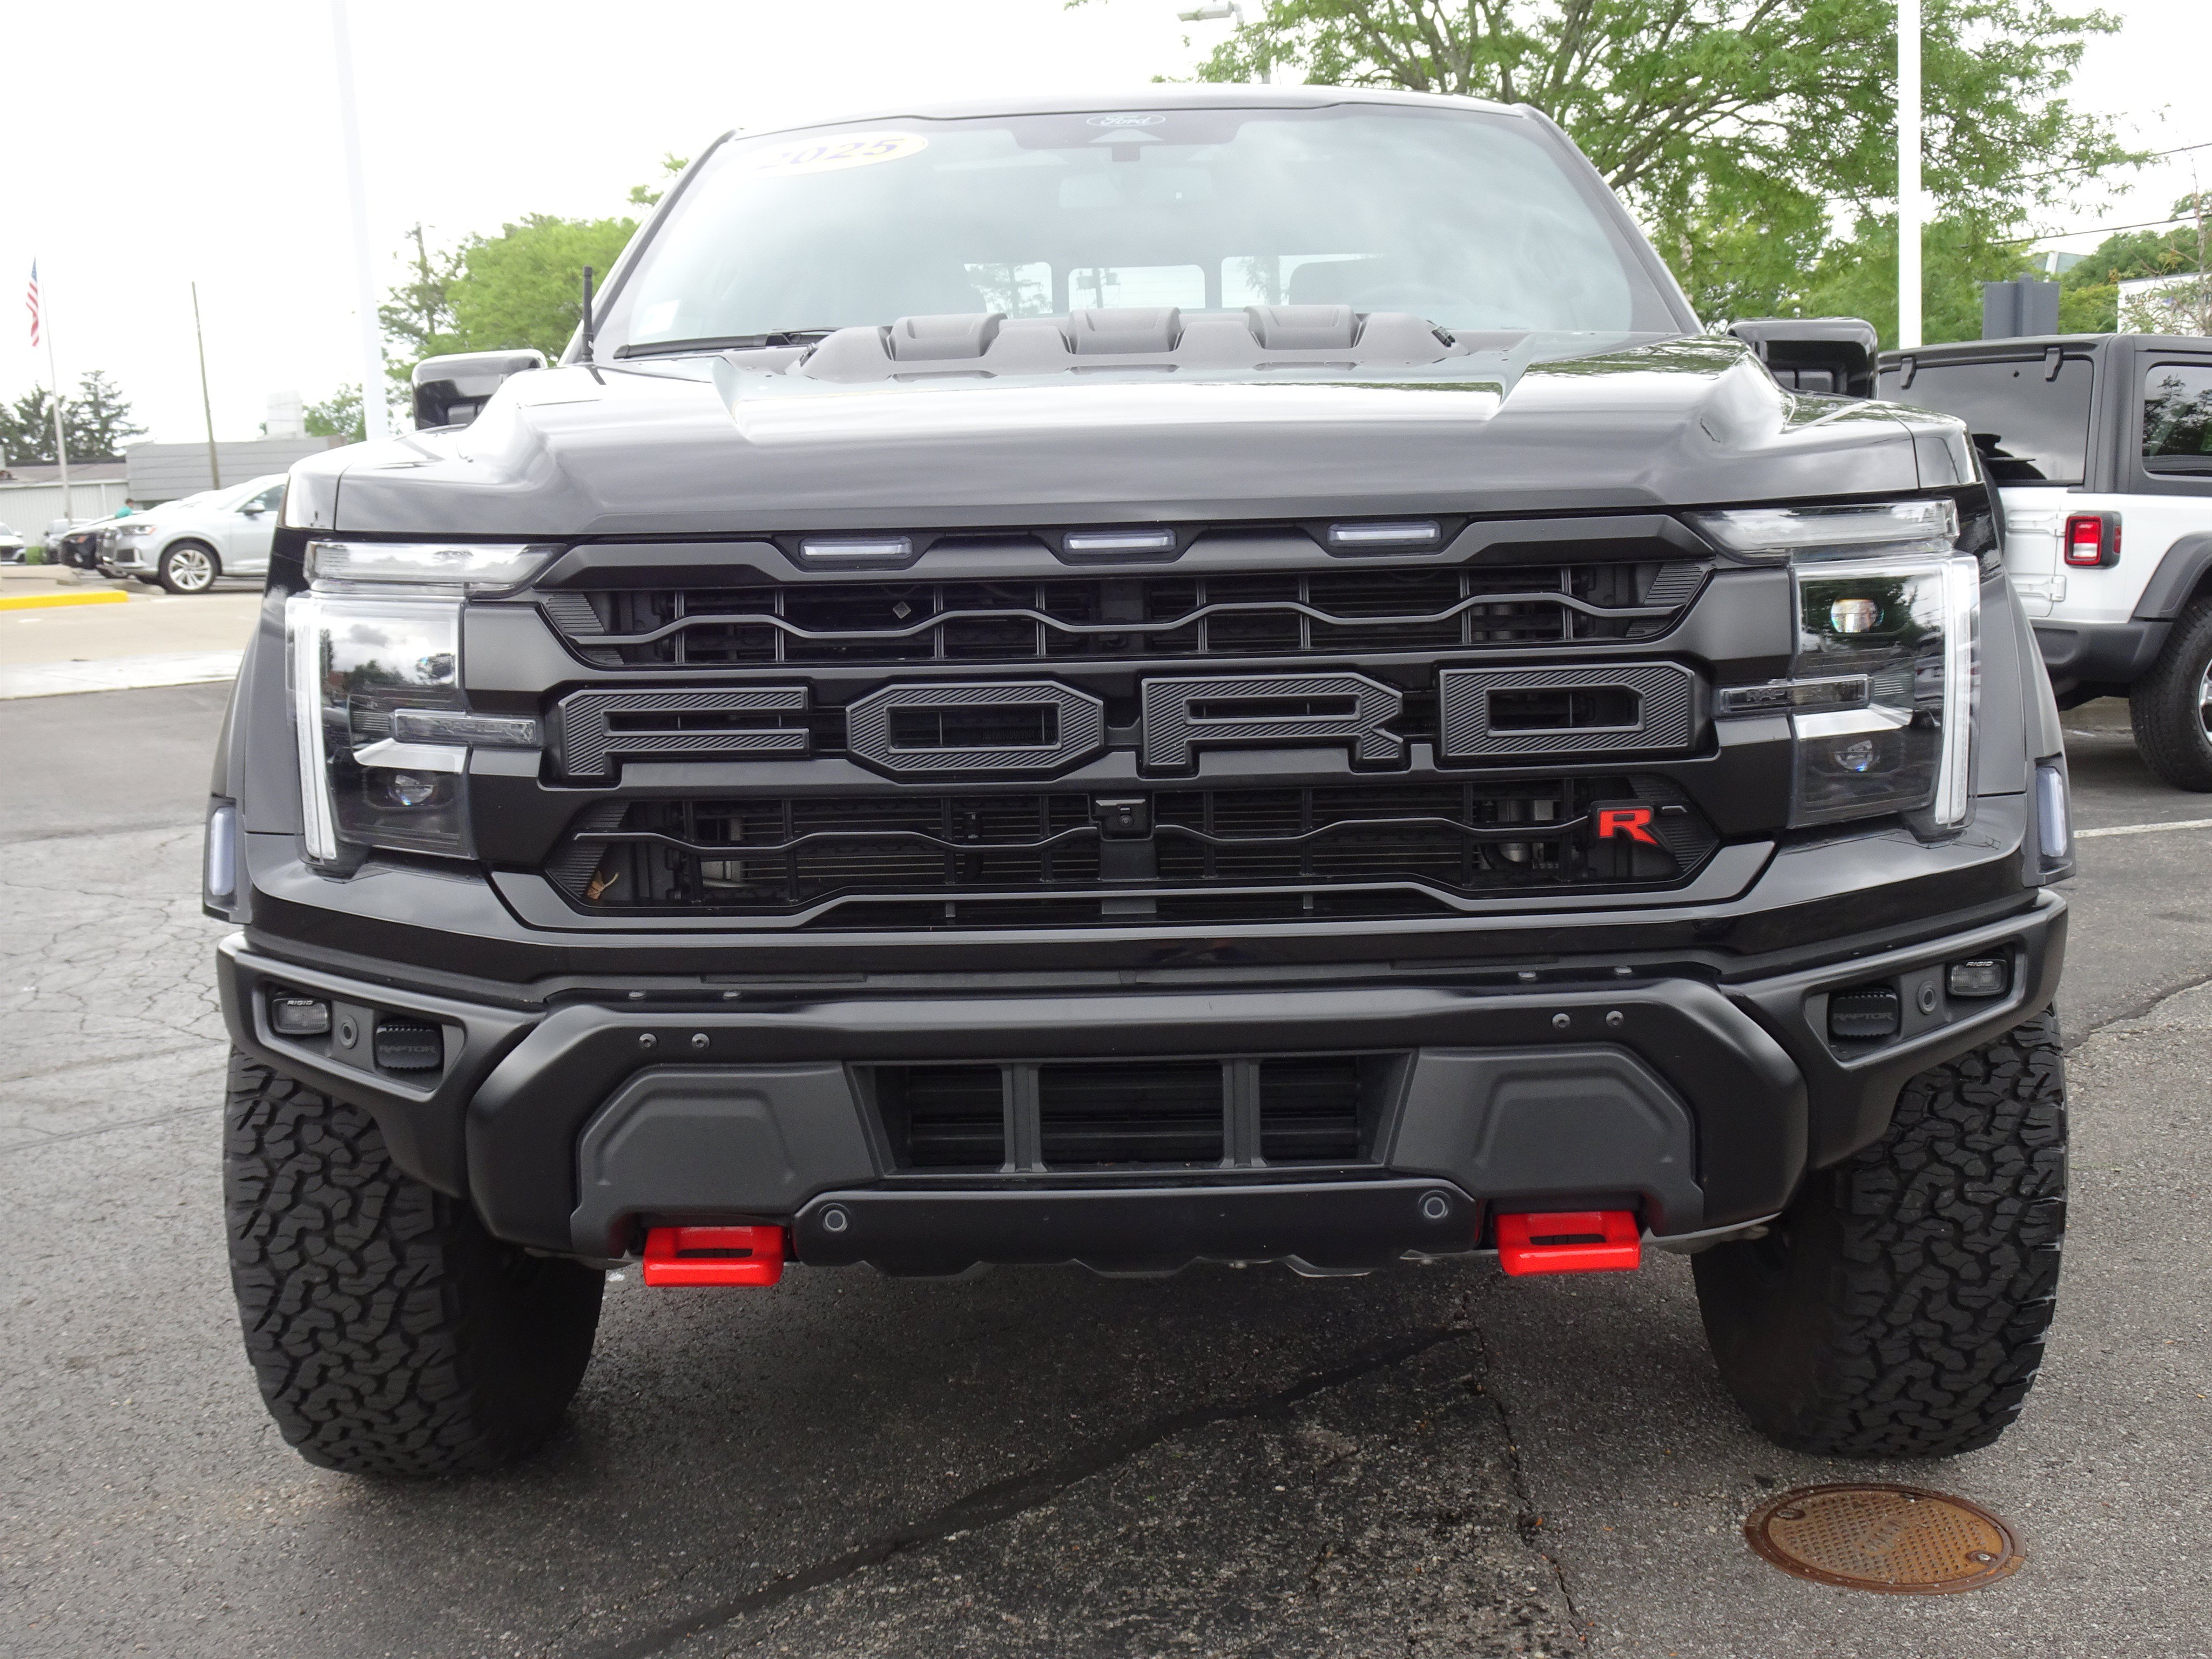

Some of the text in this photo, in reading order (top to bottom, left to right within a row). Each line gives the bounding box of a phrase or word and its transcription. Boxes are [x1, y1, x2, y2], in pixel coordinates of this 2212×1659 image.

[1100, 114, 1151, 125] Ford
[754, 138, 901, 171] 2025
[558, 661, 1696, 777] FORD
[1599, 808, 1659, 845] R
[1832, 1012, 1894, 1021] RAPTOR
[379, 1045, 437, 1054] RAPTOR
